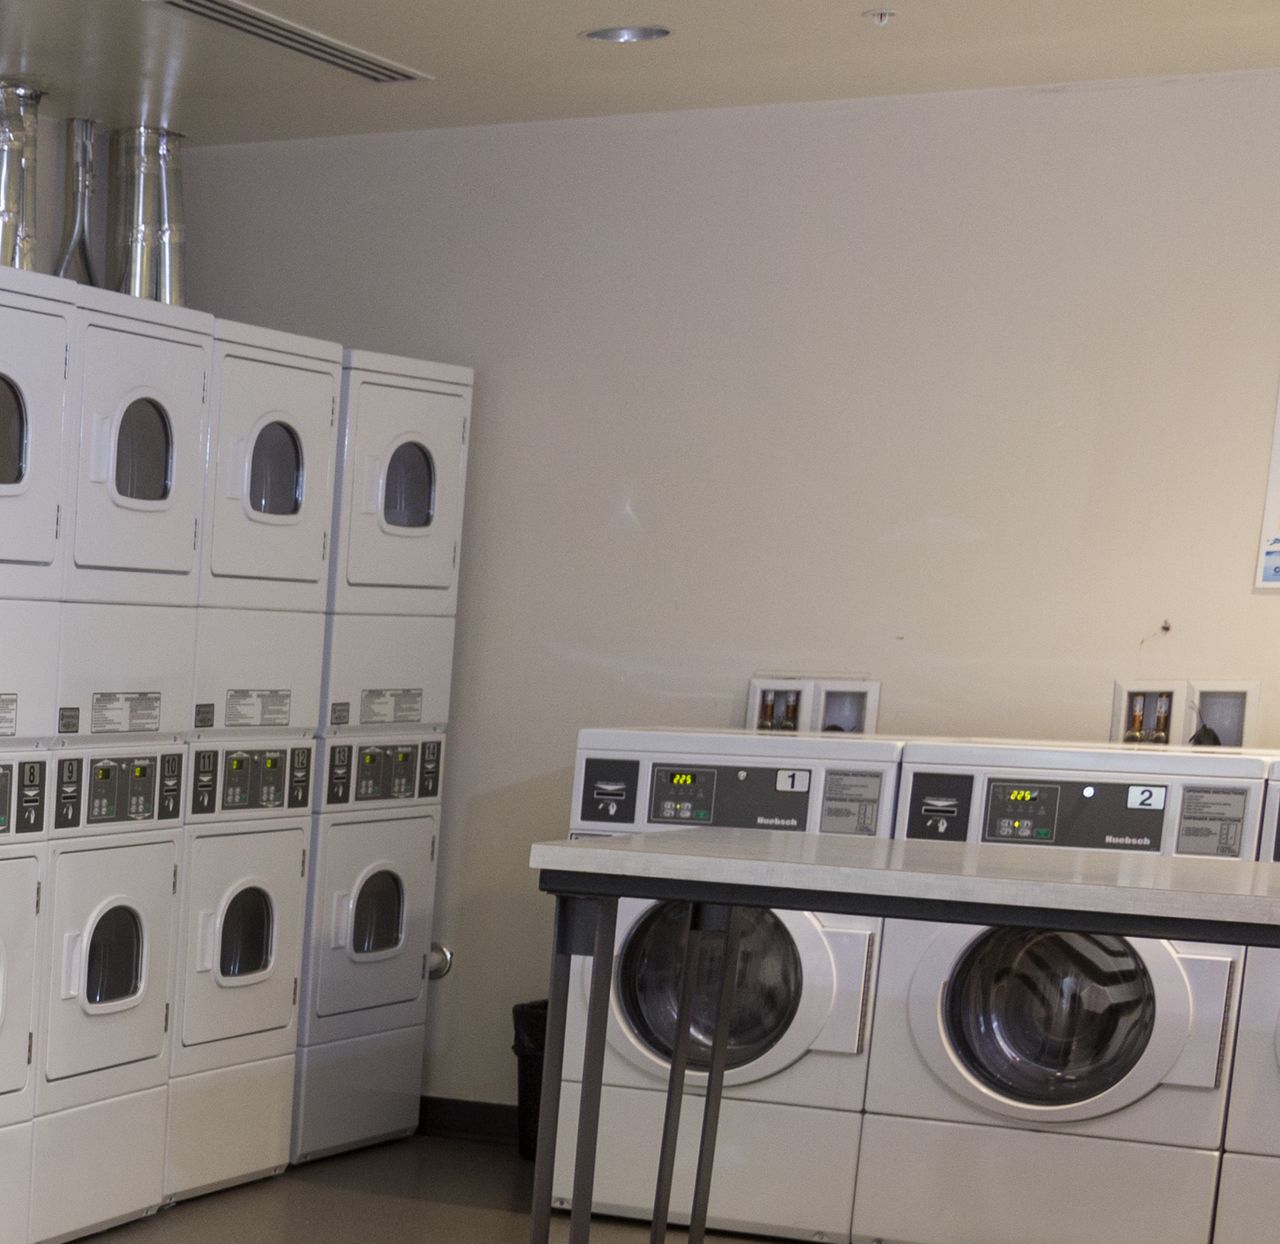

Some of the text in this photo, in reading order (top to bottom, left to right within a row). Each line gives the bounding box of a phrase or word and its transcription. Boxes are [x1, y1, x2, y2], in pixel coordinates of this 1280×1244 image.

[166, 756, 176, 776] 10
[201, 752, 211, 770] 11
[29, 766, 35, 783] 8
[68, 763, 73, 780] 9
[789, 772, 795, 789] 1
[1139, 789, 1152, 806] 2
[758, 816, 797, 827] Huebsch
[1105, 835, 1150, 845] Huebsch
